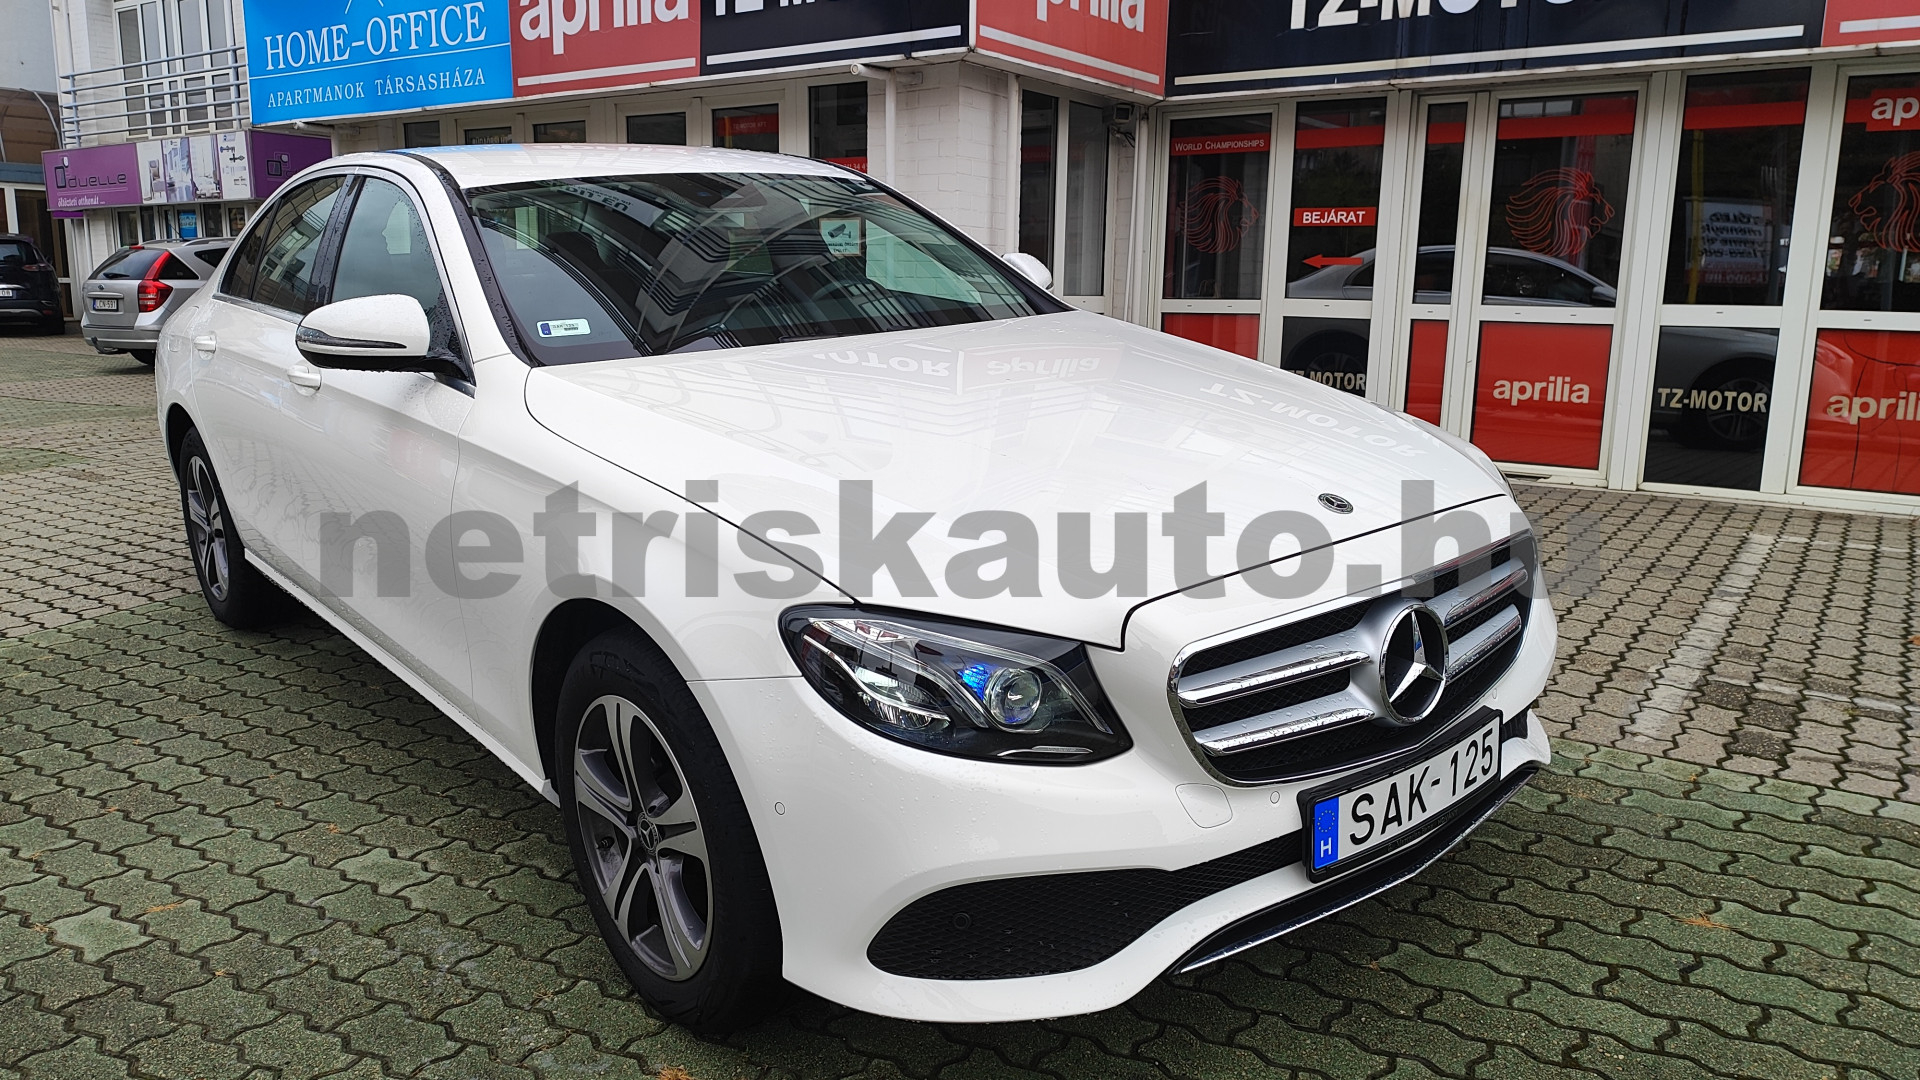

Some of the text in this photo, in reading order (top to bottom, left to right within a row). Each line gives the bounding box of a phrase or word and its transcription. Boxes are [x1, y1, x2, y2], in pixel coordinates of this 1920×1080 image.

[264, 2, 487, 71] HOME-OFFICE
[268, 66, 486, 108] APARTMANOK TÁRSASHÁZA
[1303, 209, 1366, 224] BEJÁRAT
[1493, 376, 1590, 406] aprilia
[1657, 388, 1768, 413] TZ-MOTOR
[1349, 727, 1494, 846] SAK-125
[1320, 837, 1332, 858] H
